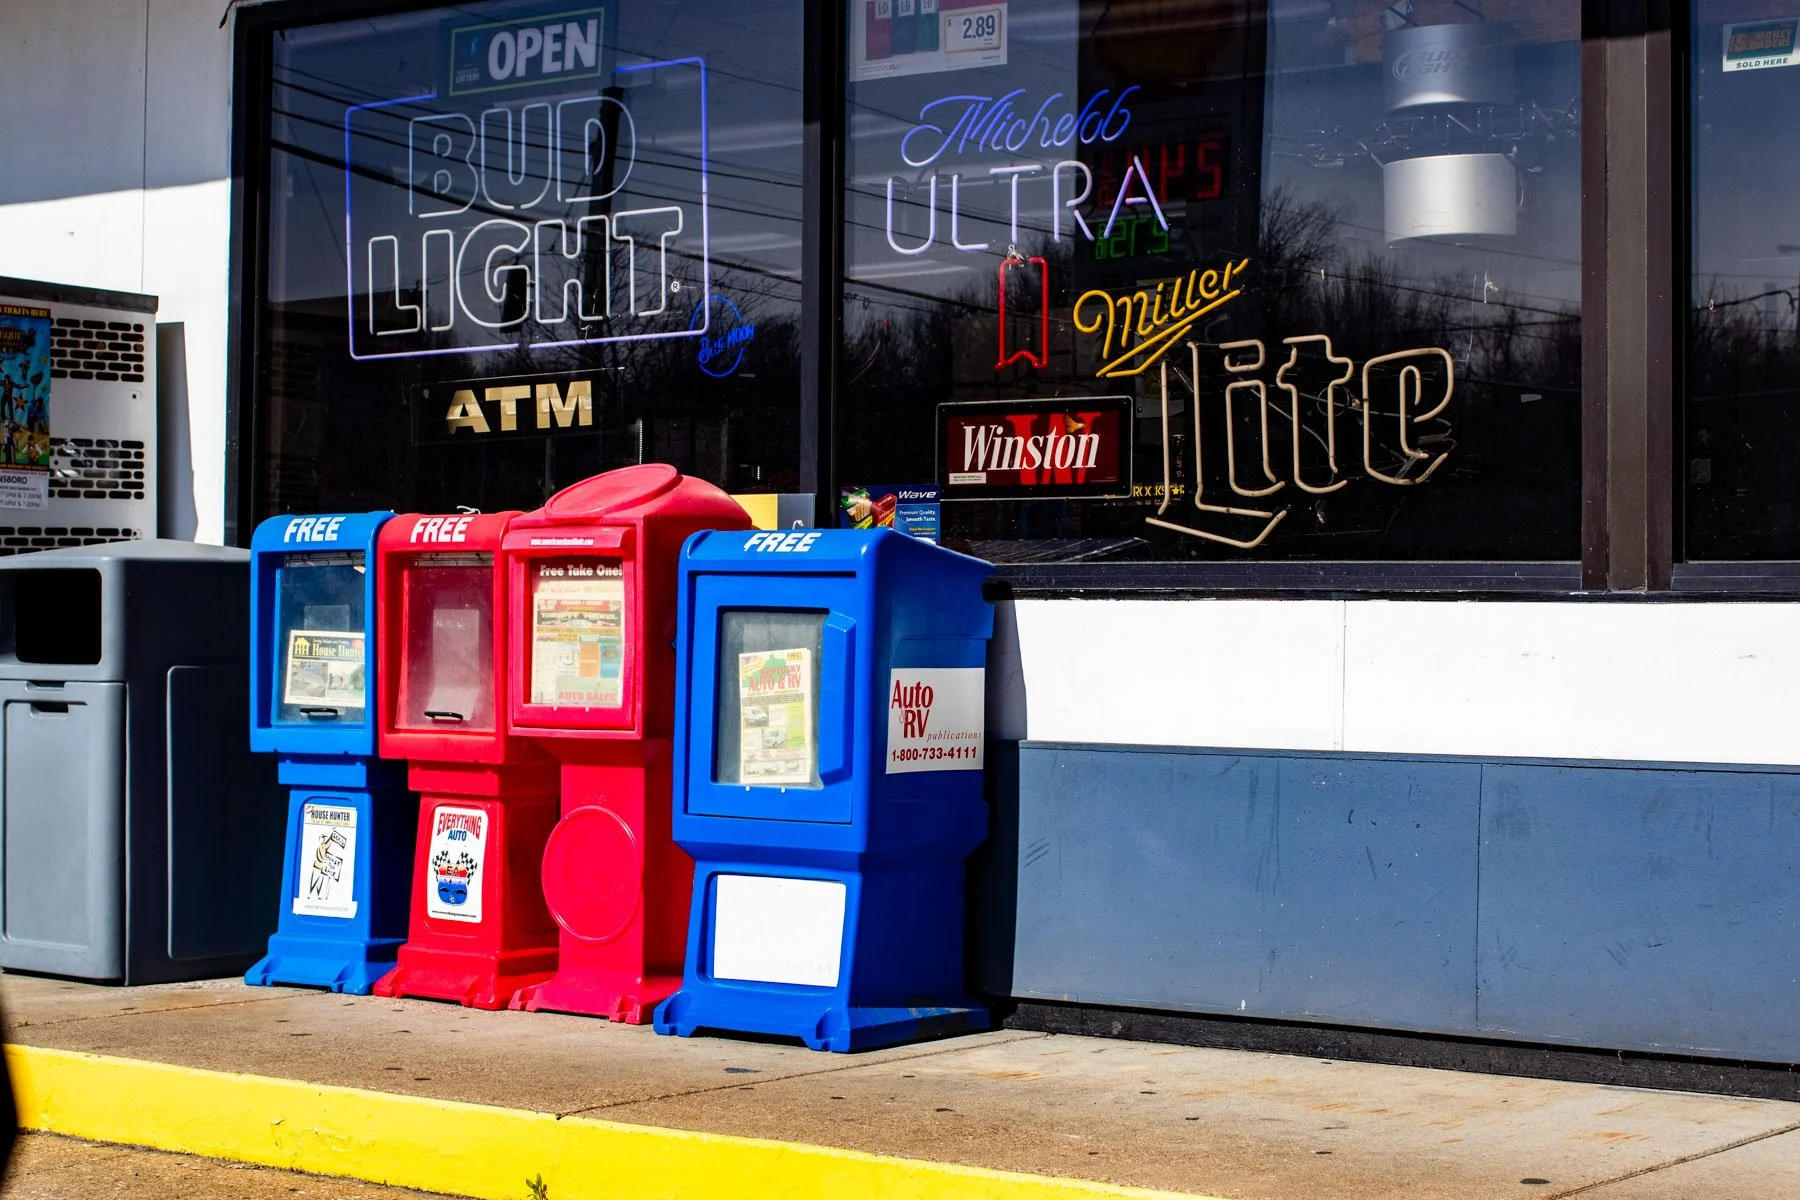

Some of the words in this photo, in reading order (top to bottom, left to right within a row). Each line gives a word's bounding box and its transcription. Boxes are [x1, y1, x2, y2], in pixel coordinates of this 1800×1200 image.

[487, 19, 598, 81] OPEN
[1736, 60, 1761, 69] SOLD
[1763, 57, 1789, 66] HERE
[901, 85, 1141, 167] Michelob
[408, 96, 636, 218] BUD
[887, 155, 1169, 255] ULTRA
[368, 206, 683, 336] LIGHT
[1073, 258, 1249, 362] Miller
[446, 381, 593, 434] ATM
[963, 424, 1101, 471] Winston
[1145, 334, 1454, 549] Lite
[898, 491, 937, 500] Wave
[283, 516, 346, 543] FREE
[410, 516, 474, 543] FREE
[743, 532, 822, 552] FREE
[540, 565, 564, 577] Free
[567, 564, 593, 577] Take
[596, 564, 622, 577] One!
[312, 643, 336, 657] House
[749, 675, 775, 692] AUTO
[787, 672, 802, 689] RV
[891, 679, 934, 709] Auto
[903, 709, 930, 738] RV
[926, 731, 983, 743] publications
[892, 746, 977, 762] 1-800-733-4111
[311, 809, 329, 820] HOUSE
[329, 811, 351, 822] HUNTER
[436, 813, 482, 840] EVERYTHING
[447, 829, 467, 842] AUTO
